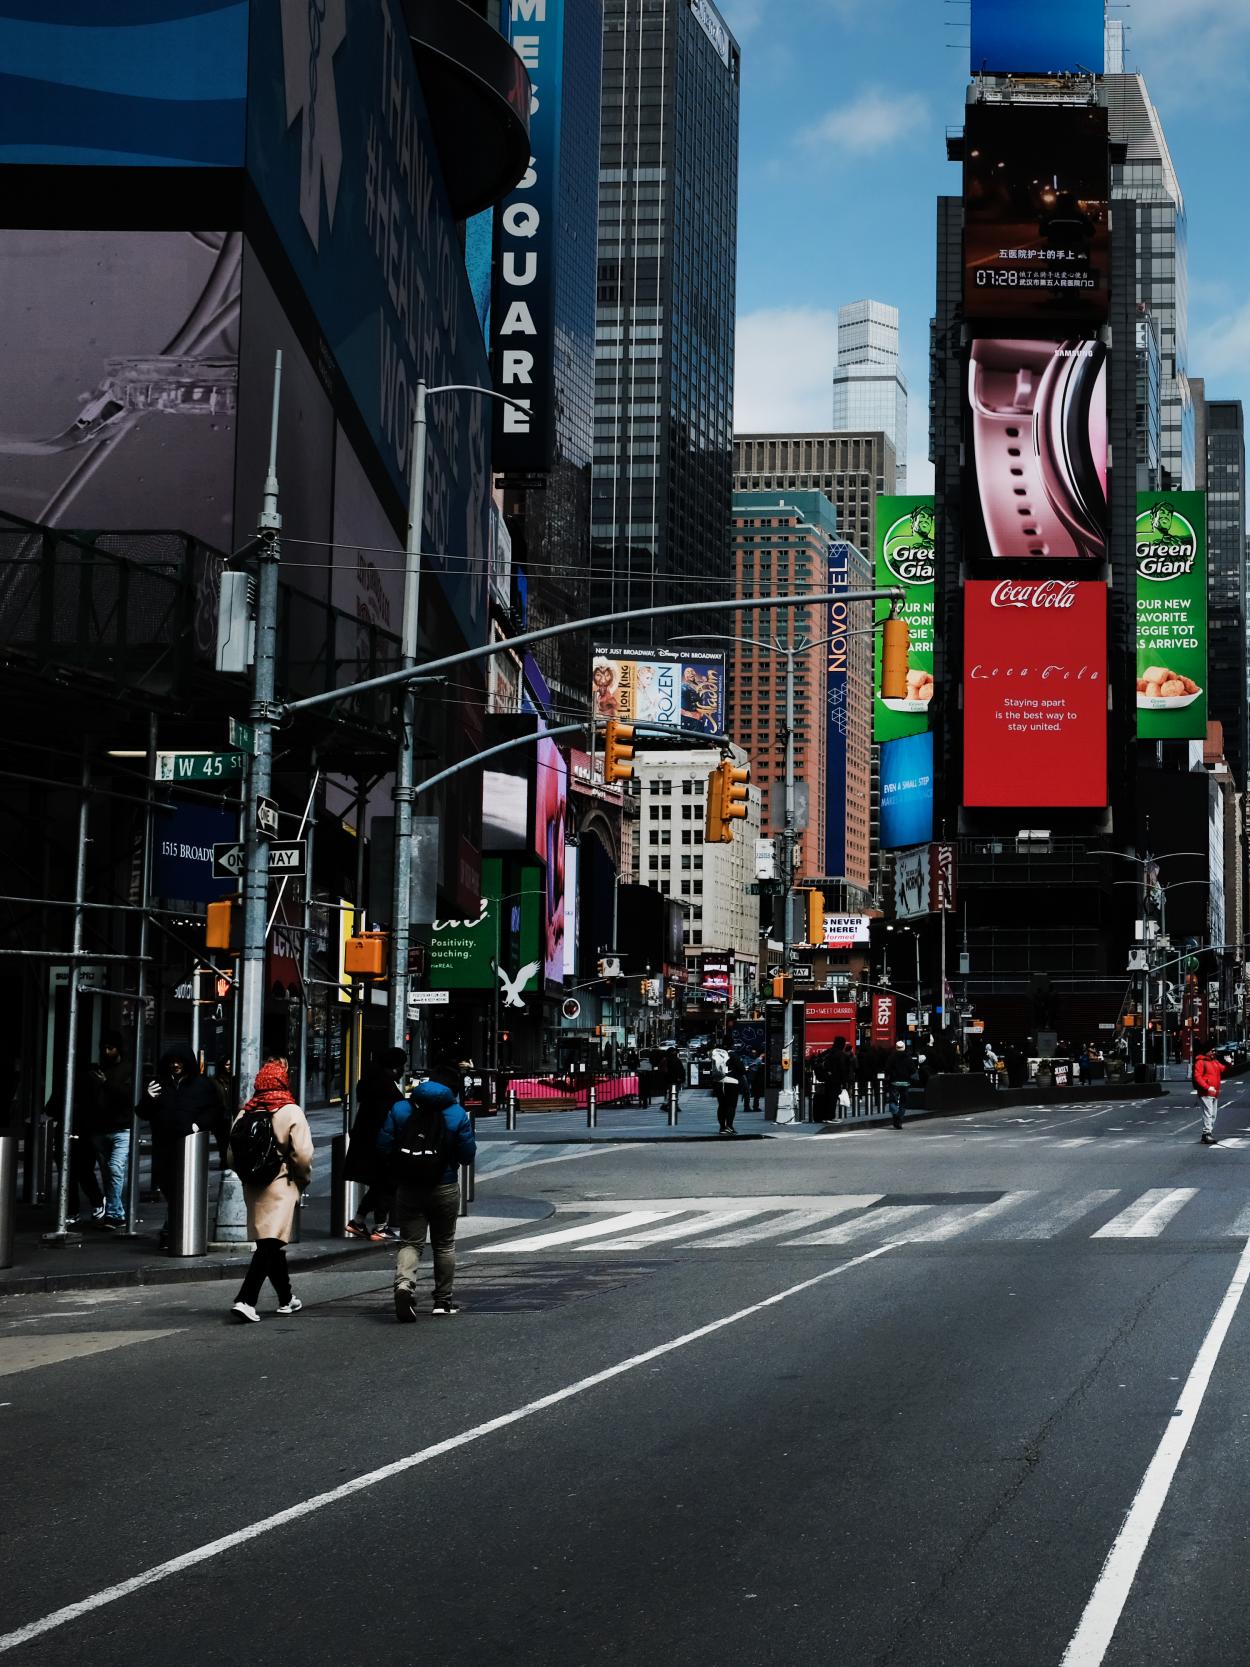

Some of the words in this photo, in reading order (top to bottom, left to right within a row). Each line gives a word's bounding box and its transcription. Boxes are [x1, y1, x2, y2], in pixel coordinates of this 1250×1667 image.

[976, 270, 1018, 286] 07:28
[380, 304, 449, 571] WORERS!
[1136, 541, 1192, 557] Green
[1140, 557, 1194, 573] Giant
[1164, 600, 1191, 609] NEW
[1172, 626, 1195, 635] TOT
[1149, 639, 1198, 648] ARRIVED
[691, 652, 723, 660] BROADWAY
[618, 665, 631, 688] KING
[618, 690, 631, 713] LION
[657, 666, 676, 723] ROZEN
[1004, 699, 1039, 708] Staying
[1041, 699, 1065, 708] apart
[995, 711, 1003, 720] is
[1005, 711, 1021, 720] the
[1023, 711, 1044, 720] best
[1046, 712, 1065, 722] way
[1067, 712, 1077, 720] to
[1008, 724, 1027, 733] stay
[1030, 722, 1061, 731] united.
[179, 758, 195, 777] W
[203, 757, 223, 776] 45
[231, 756, 243, 768] St
[162, 842, 178, 857] 1515
[228, 855, 245, 867] ON
[431, 938, 477, 949] Positivity.
[878, 997, 893, 1025] tkts
